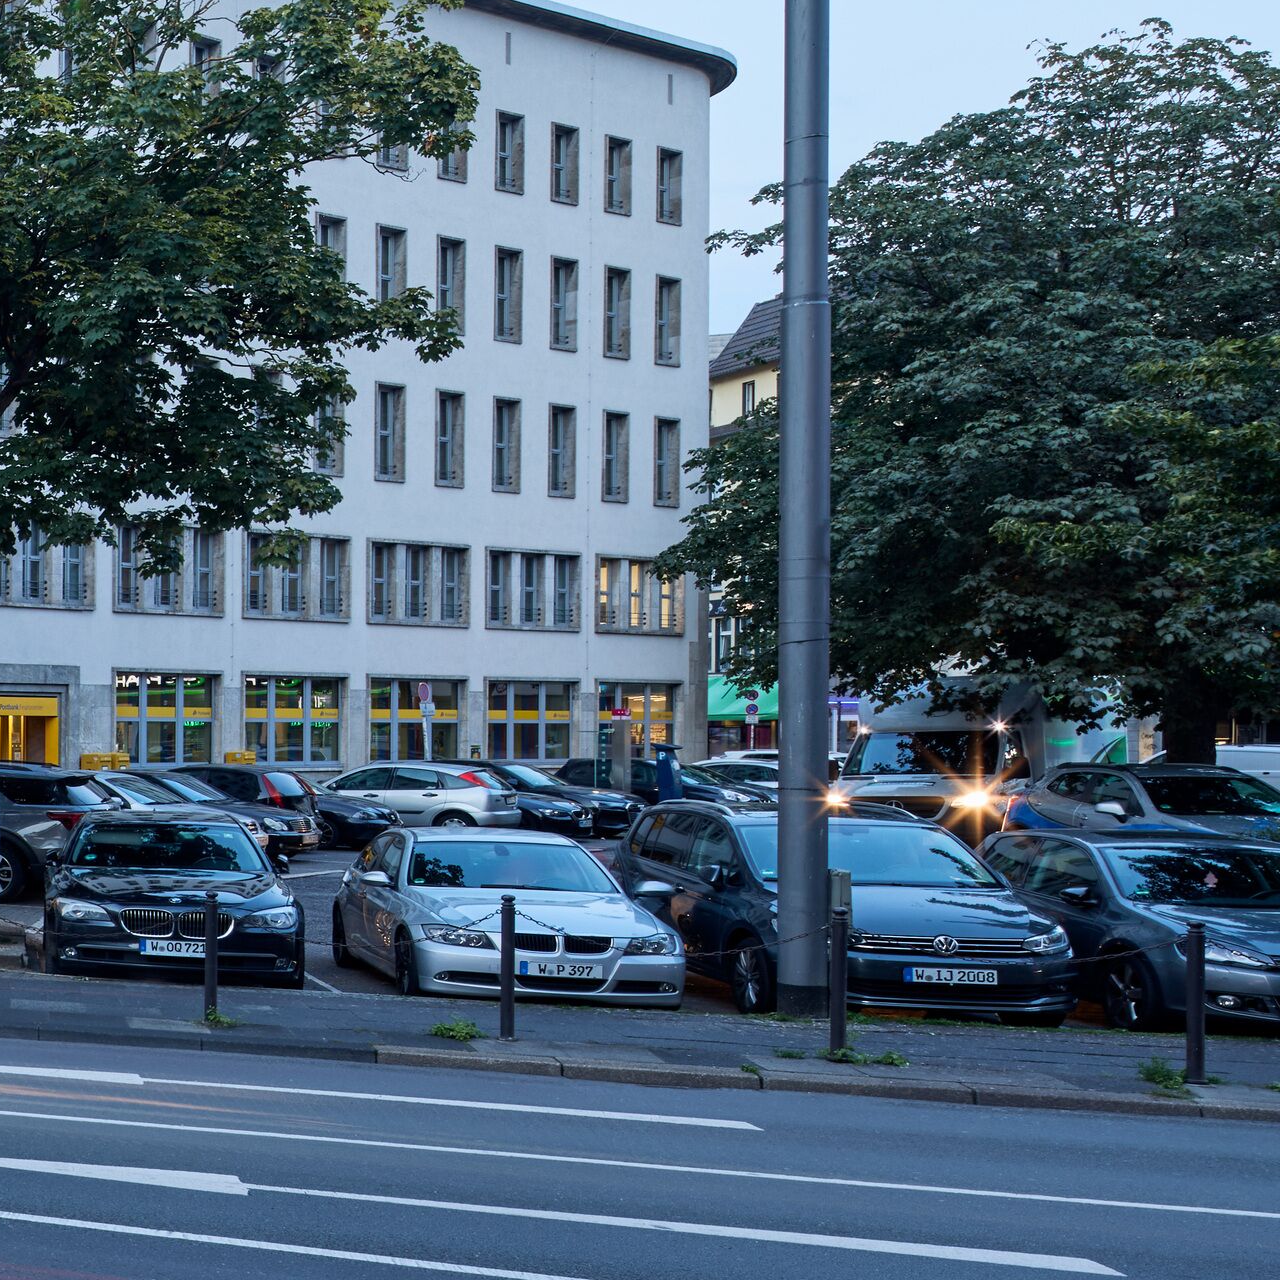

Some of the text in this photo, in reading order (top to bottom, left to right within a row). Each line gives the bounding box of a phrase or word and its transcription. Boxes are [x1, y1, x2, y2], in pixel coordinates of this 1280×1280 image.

[659, 751, 666, 760] P
[151, 941, 159, 952] W
[166, 942, 182, 953] OQ
[538, 963, 594, 977] W P 397
[915, 969, 995, 983] W IJ 2008
